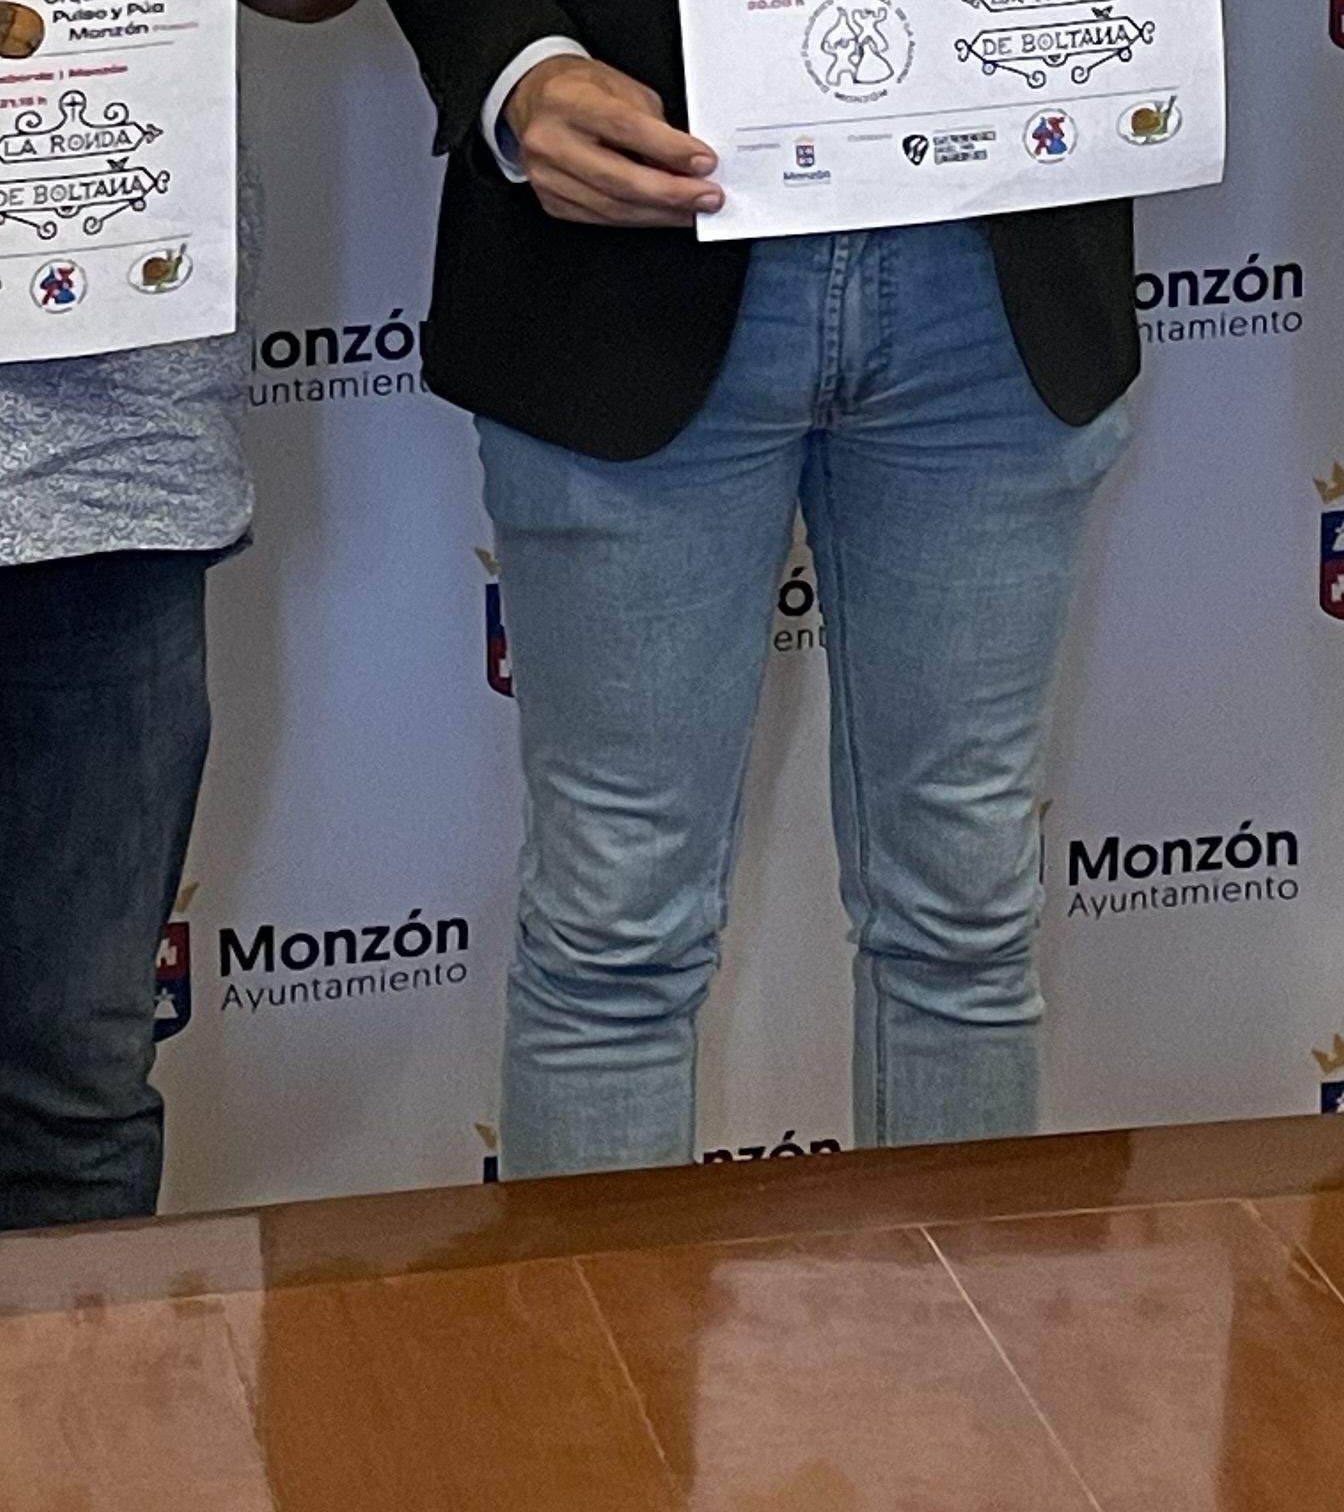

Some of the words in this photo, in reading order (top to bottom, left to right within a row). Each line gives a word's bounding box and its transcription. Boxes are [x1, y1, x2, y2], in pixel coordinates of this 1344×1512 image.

[69, 21, 149, 41] Monzón
[111, 7, 121, 21] y
[982, 36, 1012, 56] DE
[4, 138, 37, 157] LA
[1134, 253, 1303, 310] onzón
[251, 308, 428, 372] onzó
[1137, 311, 1303, 343] ntamiento
[1069, 819, 1298, 886] Monzón
[1067, 877, 1299, 920] Ayuntamiento
[219, 908, 469, 977] Monzón
[221, 962, 467, 1014] Ayuntamiento
